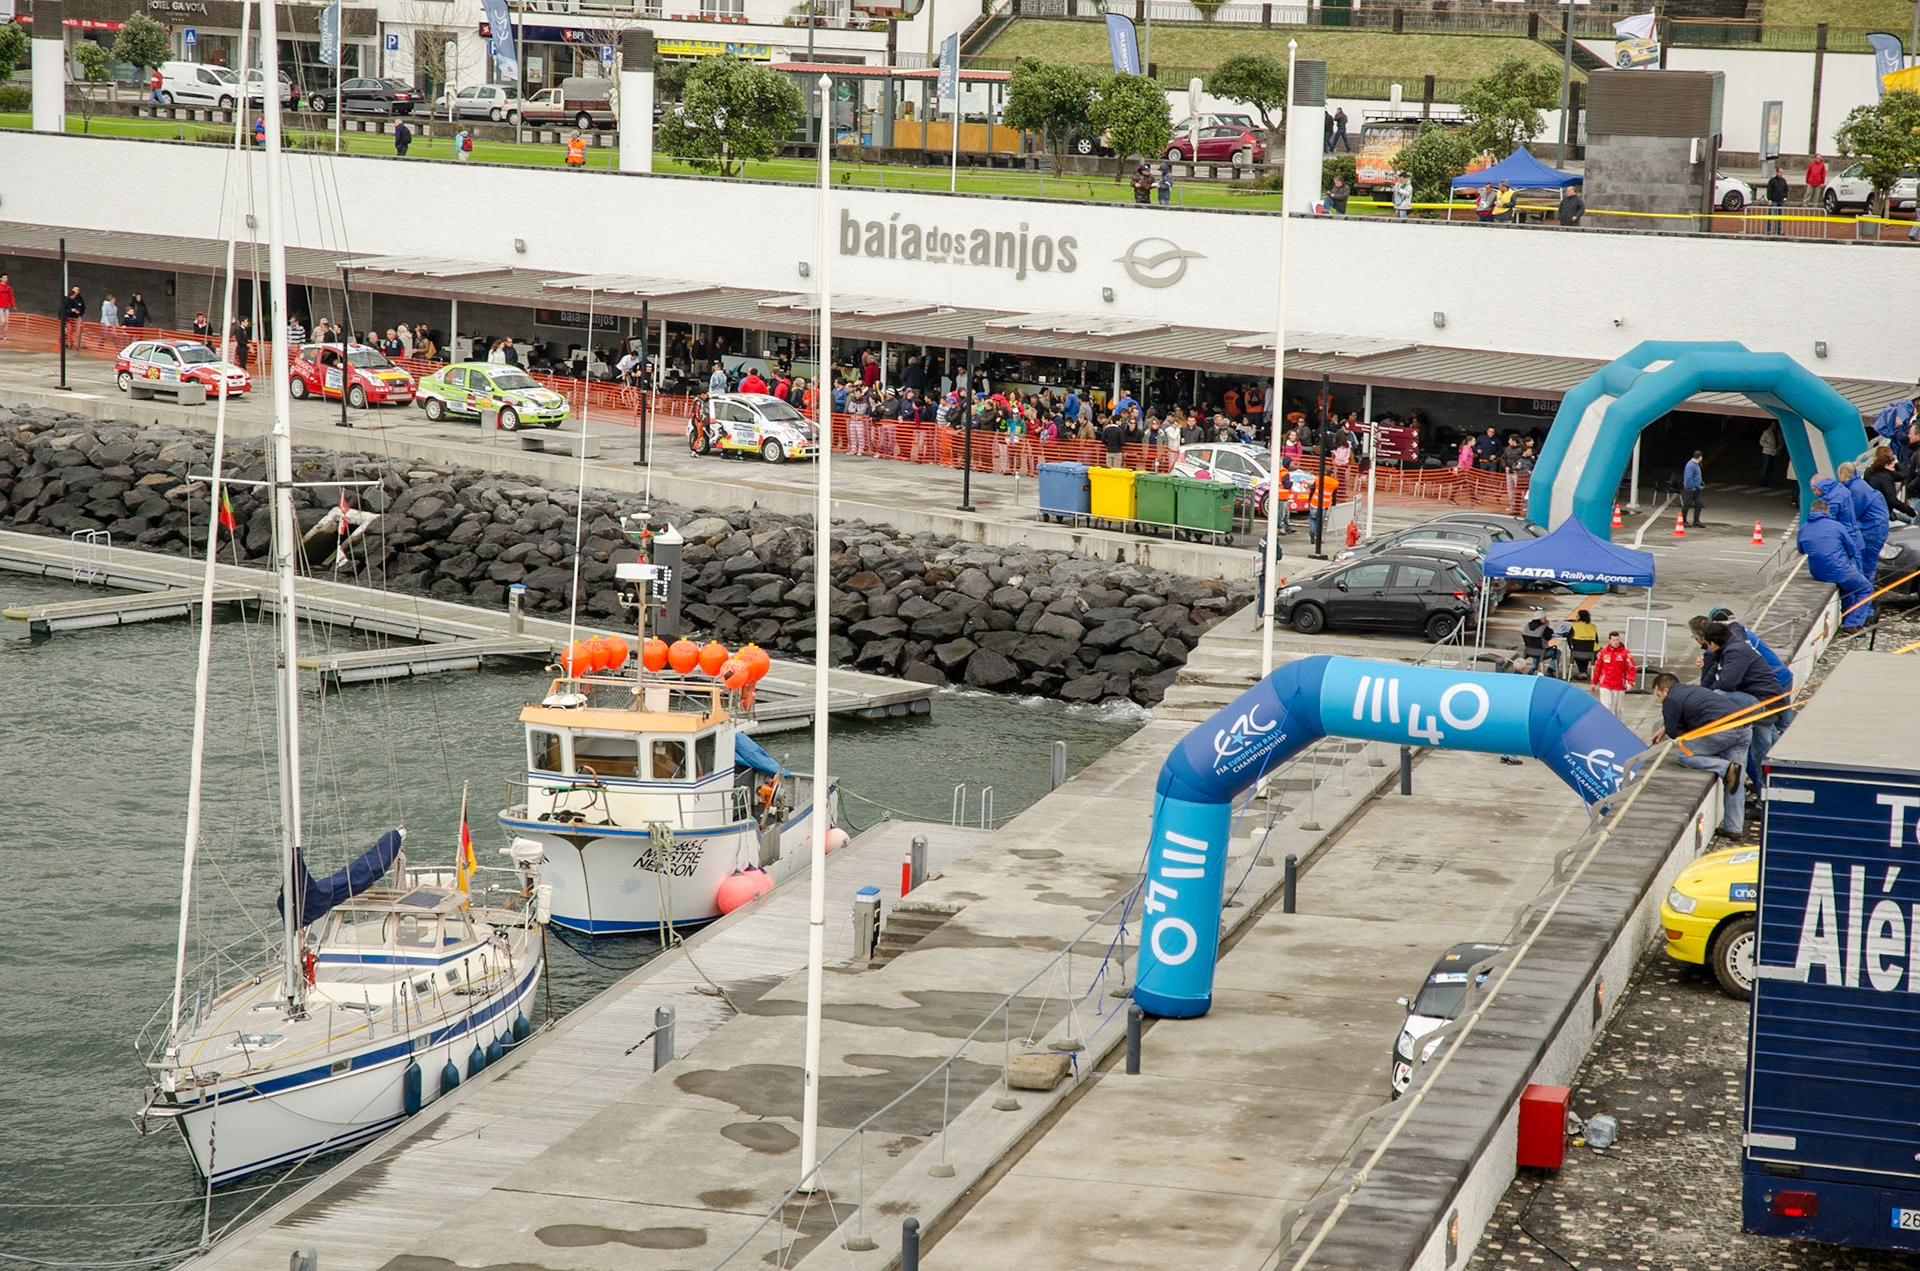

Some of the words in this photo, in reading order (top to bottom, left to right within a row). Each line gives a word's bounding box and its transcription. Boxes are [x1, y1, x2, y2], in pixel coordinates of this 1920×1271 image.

[172, 1, 208, 16] GAVOTA
[388, 36, 397, 49] P
[573, 31, 585, 39] BPI
[603, 45, 612, 59] P
[660, 40, 720, 48] RENT-A-CAR
[840, 208, 922, 260] baía
[926, 226, 966, 255] dos
[970, 222, 1078, 280] anjos
[1505, 566, 1556, 579] SATA
[1560, 570, 1595, 582] Rallye
[1596, 572, 1635, 584] Açores
[1215, 765, 1229, 776] FIA
[1228, 742, 1263, 768] EUROPEAN
[1262, 729, 1283, 744] RALLY
[1232, 733, 1287, 773] CHAMPIONSHIP
[1563, 754, 1576, 767] FIA
[1570, 769, 1604, 801] CHAMPIO
[1876, 793, 1920, 849] T
[642, 847, 704, 864] MESTRE
[633, 857, 697, 877] NELSON
[1735, 888, 1757, 899] one
